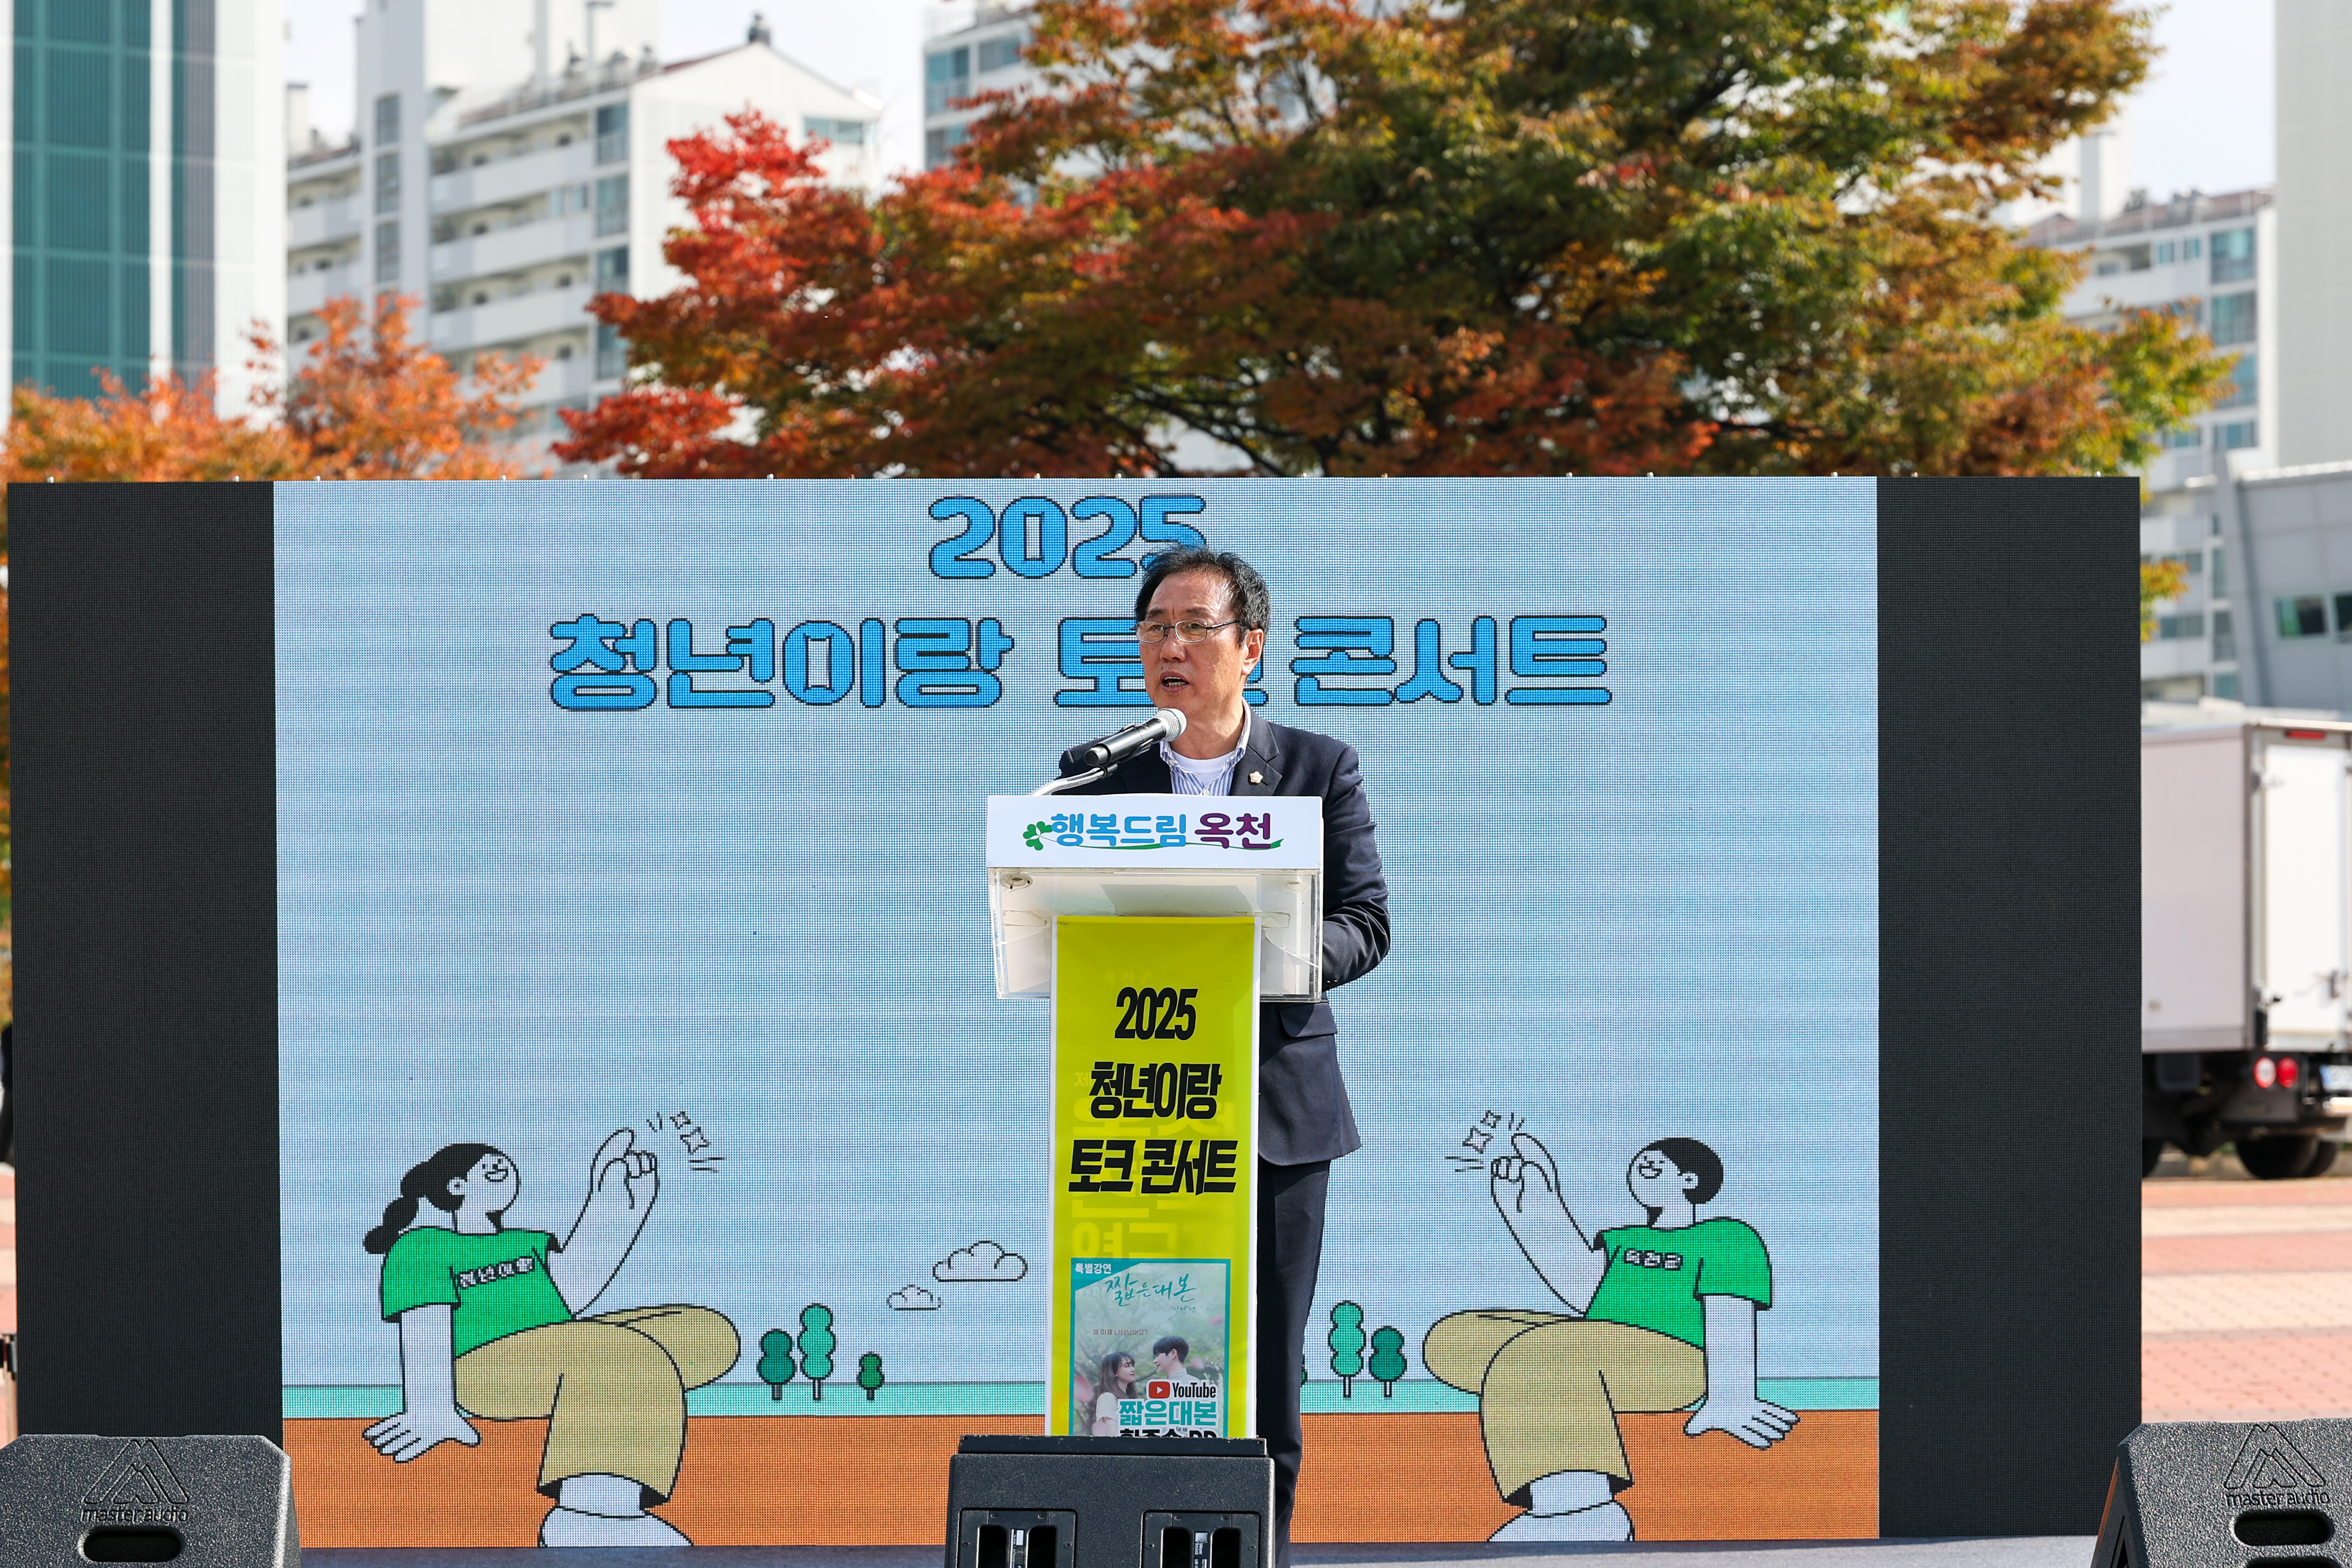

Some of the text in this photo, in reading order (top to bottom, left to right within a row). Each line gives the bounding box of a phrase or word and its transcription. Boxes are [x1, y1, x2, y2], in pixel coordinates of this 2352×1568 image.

[929, 495, 1207, 579] 2025
[550, 614, 1015, 711] 청년이랑
[1289, 615, 1613, 707] 콘서트
[1050, 812, 1272, 849] 행복드림 옥천
[1114, 986, 1199, 1041] 2025
[1089, 1061, 1223, 1120] 청년이랑
[1068, 1139, 1238, 1196] 토크 콘서트
[1075, 1263, 1111, 1274] 특별강연
[1105, 1273, 1196, 1307] 짧은대본
[1172, 1382, 1216, 1398] YouTube
[1119, 1400, 1217, 1426] 짧은대본
[81, 1505, 187, 1523] master audio
[2225, 1488, 2330, 1507] master audio
